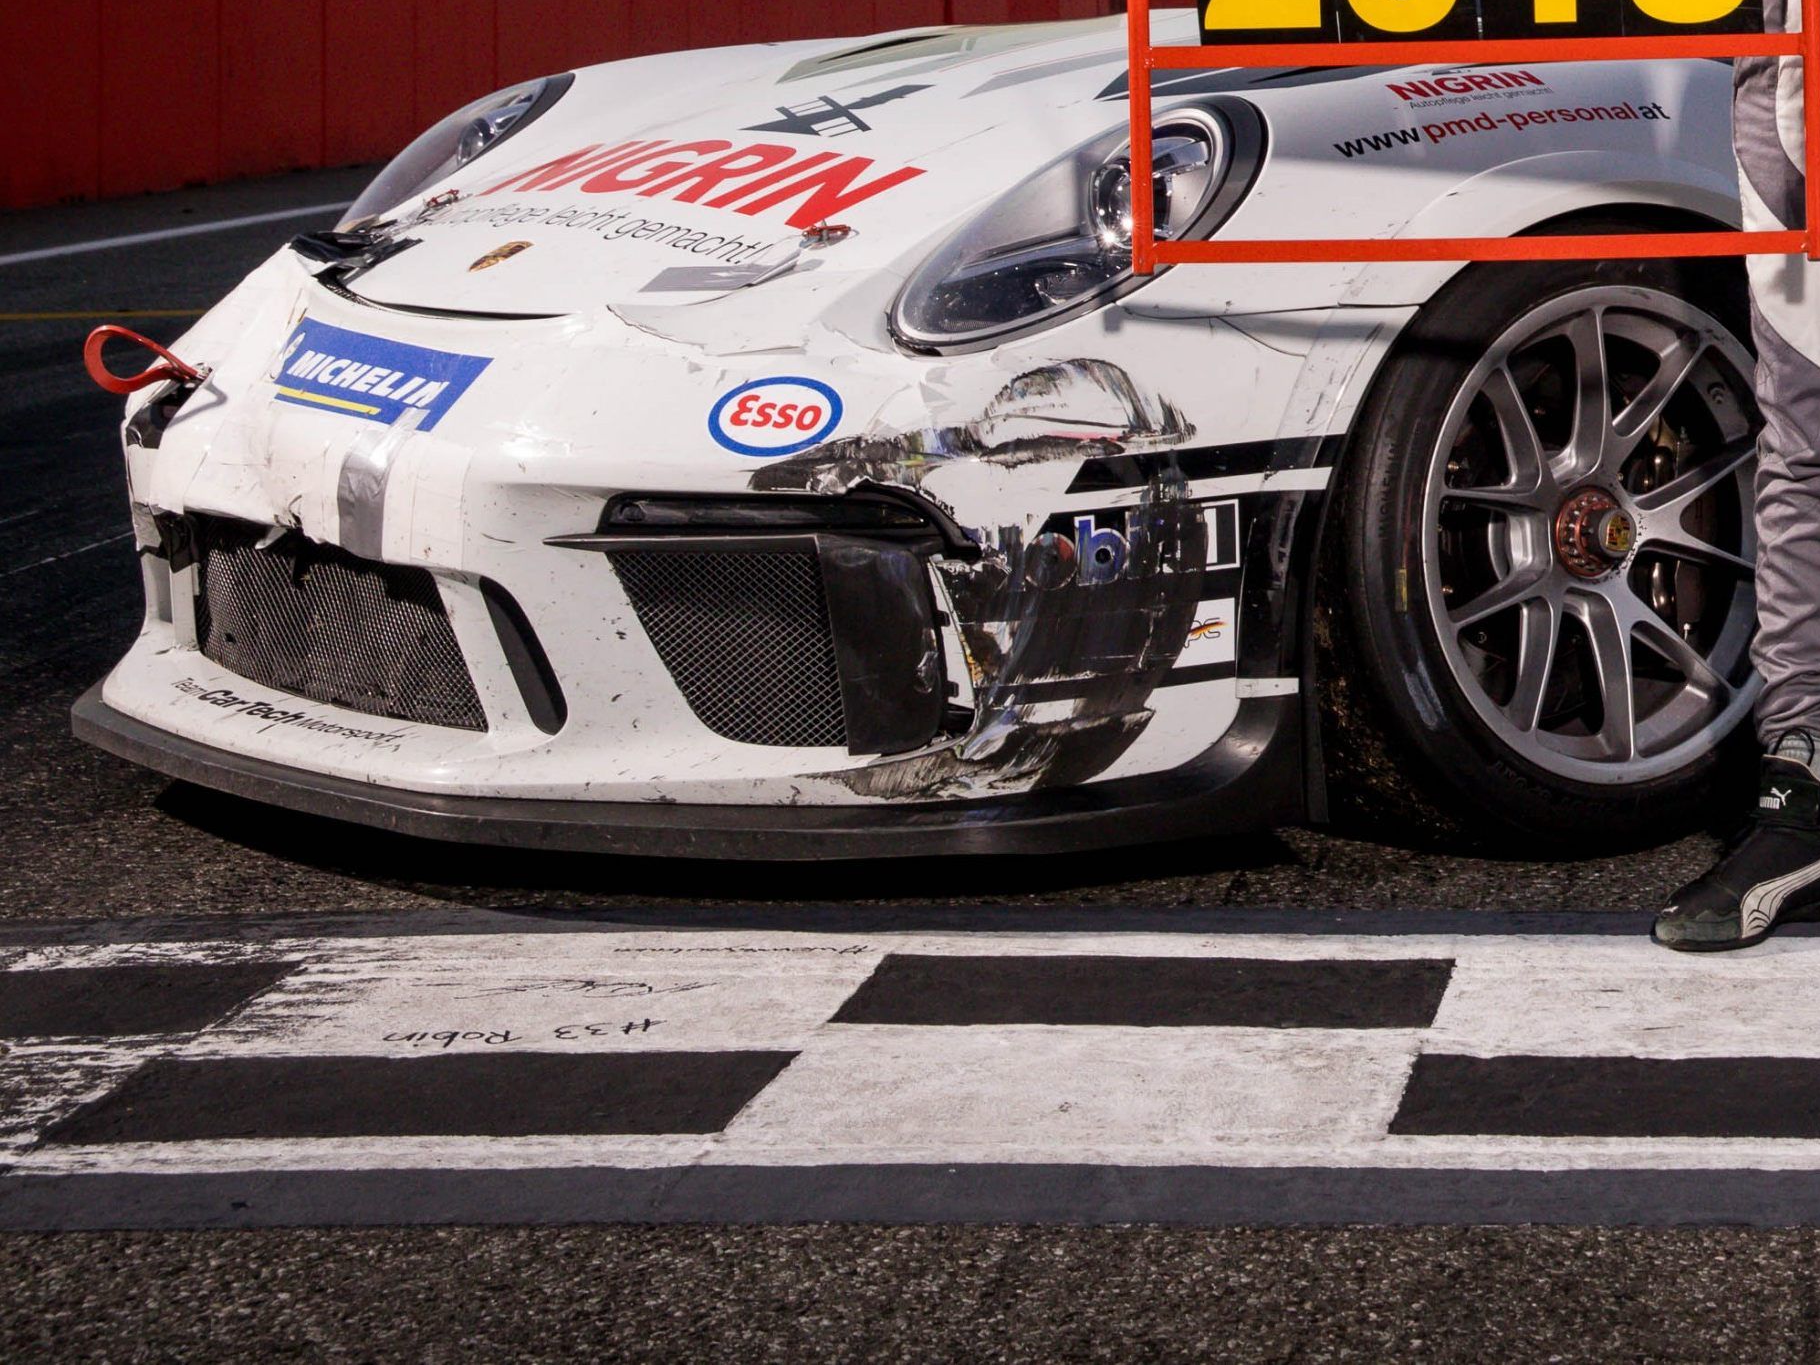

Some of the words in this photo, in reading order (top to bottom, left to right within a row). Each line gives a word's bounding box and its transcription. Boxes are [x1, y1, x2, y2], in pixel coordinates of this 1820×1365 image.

[1386, 70, 1546, 101] NIGRIN
[474, 139, 928, 231] NIGRIN
[545, 204, 626, 231] leicht
[603, 216, 774, 265] gemacht!
[286, 350, 450, 408] MICHELIN
[729, 394, 822, 433] Esso
[171, 677, 207, 696] Team
[198, 689, 306, 724] CarTech
[383, 1027, 523, 1049] Robin
